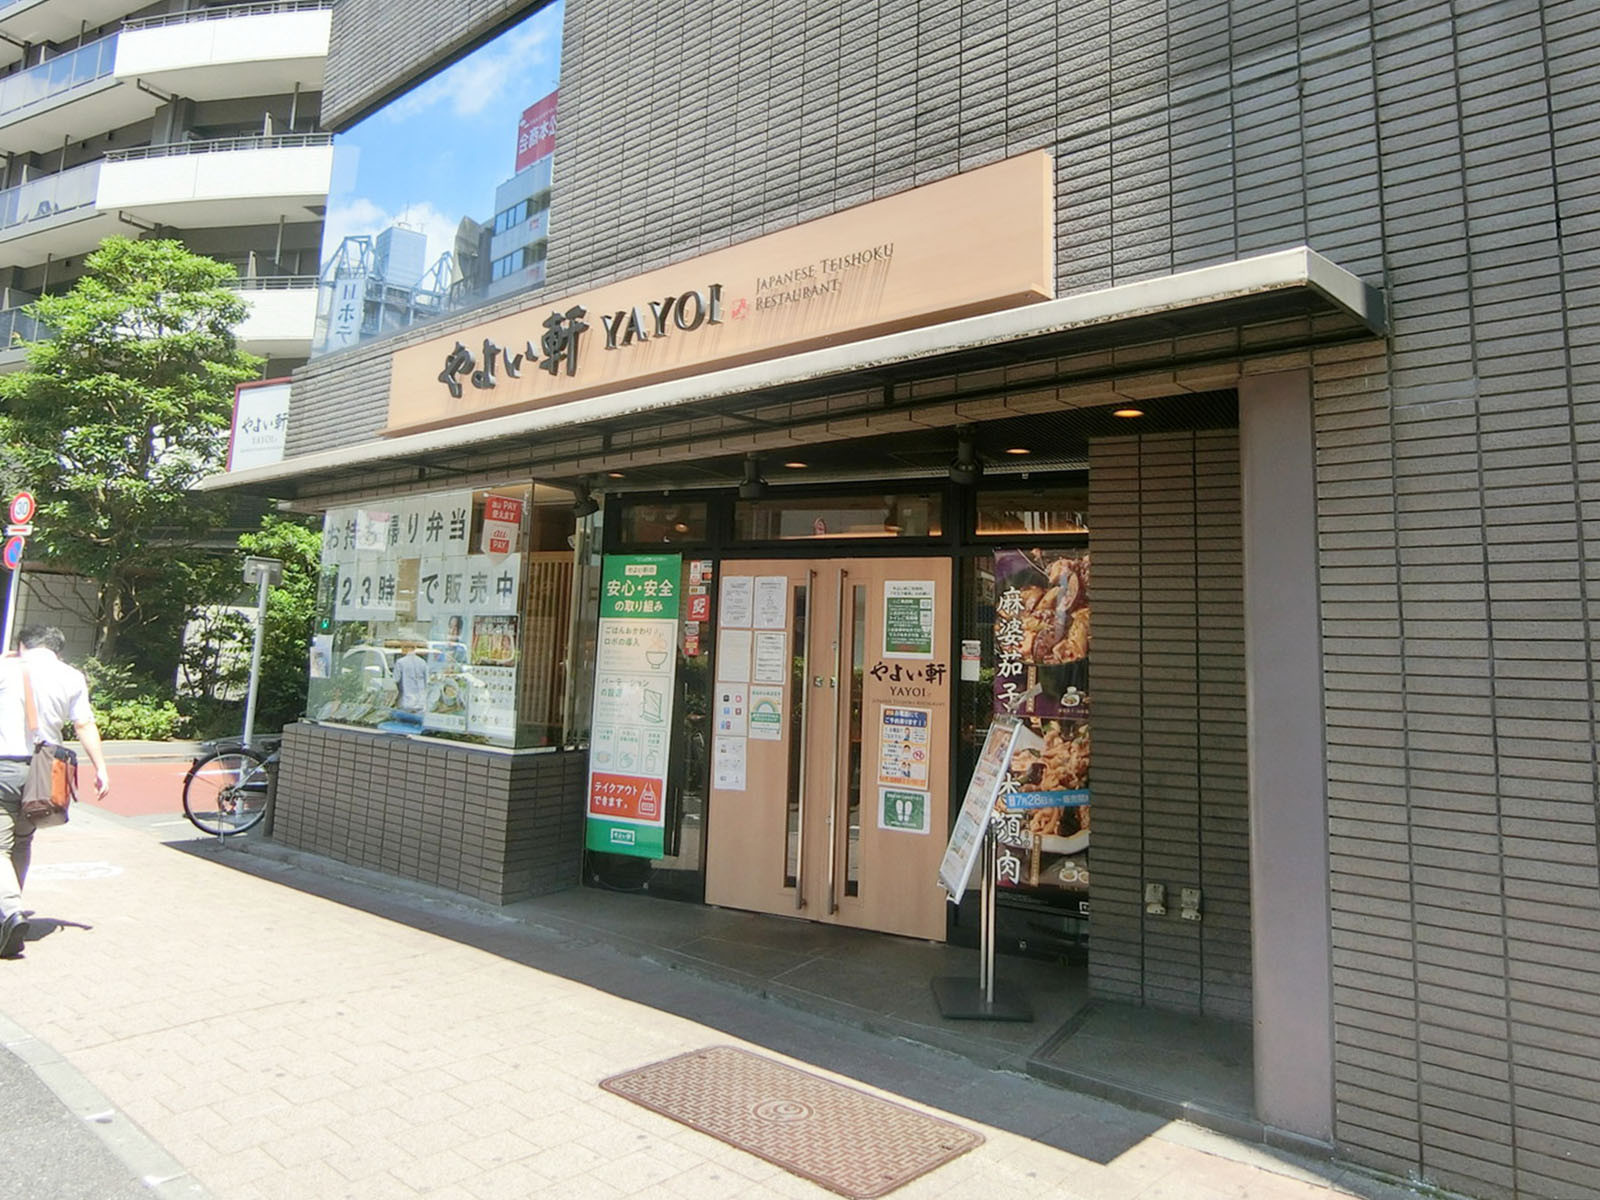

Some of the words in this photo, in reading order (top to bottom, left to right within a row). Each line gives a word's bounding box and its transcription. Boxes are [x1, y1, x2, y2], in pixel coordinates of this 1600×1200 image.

[756, 265, 815, 294] JAPANESE
[820, 243, 894, 274] TEISHOKU
[755, 278, 839, 311] RESTAURANT
[438, 304, 589, 398] やよい軒
[601, 283, 723, 351] YAYOI
[607, 579, 674, 597] 安心・安全
[869, 661, 947, 686] やよい軒
[889, 686, 926, 698] YAYOI
[594, 781, 638, 796] テイクアウト
